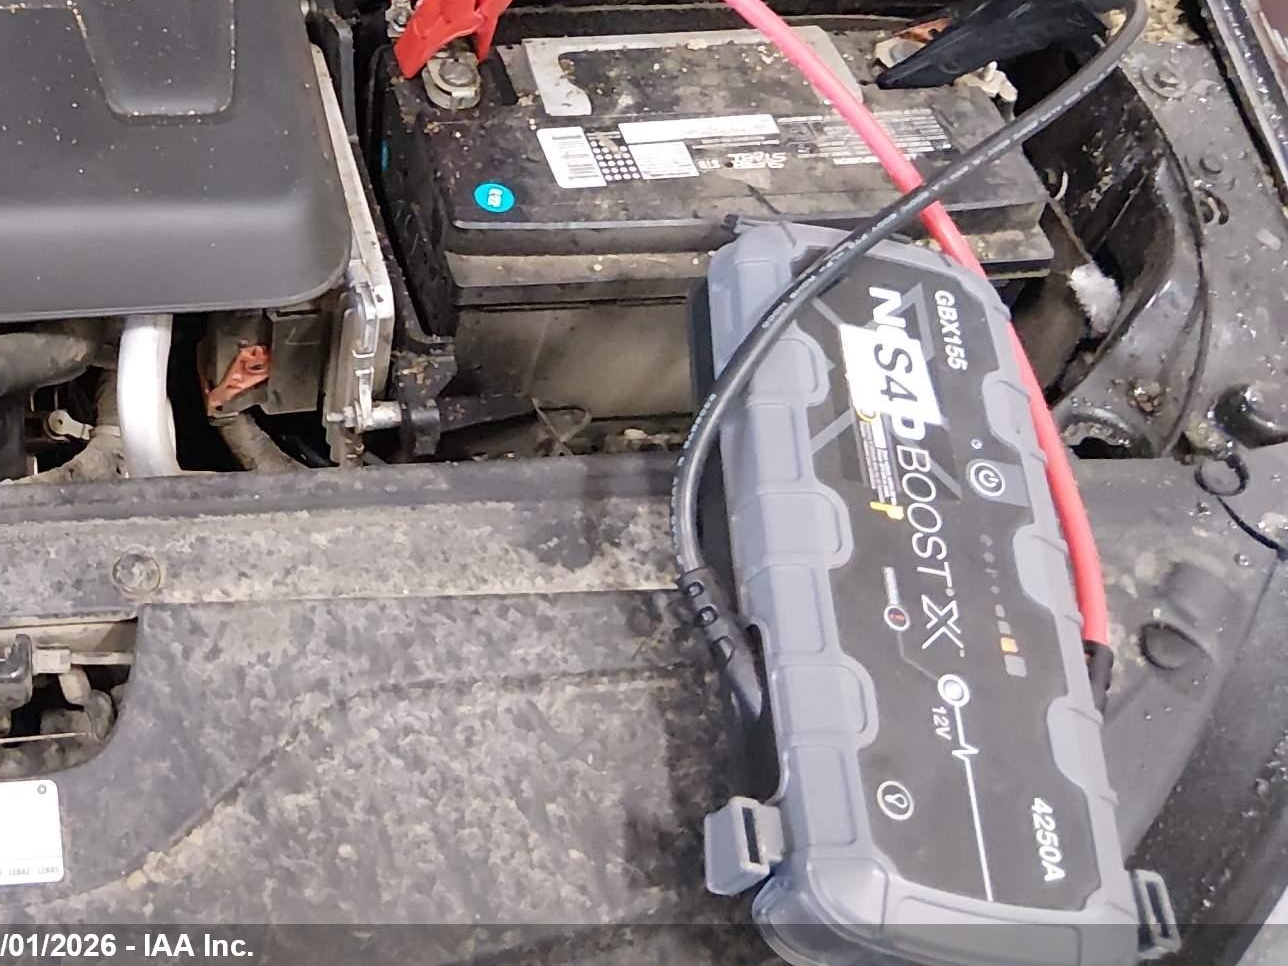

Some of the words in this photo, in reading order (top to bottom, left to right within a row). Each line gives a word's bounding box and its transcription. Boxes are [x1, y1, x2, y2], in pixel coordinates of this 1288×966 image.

[934, 289, 969, 371] GBX155
[873, 342, 919, 403] S4
[895, 444, 954, 588] BOOST
[931, 705, 953, 741] 12V
[1030, 796, 1066, 882] 4250A
